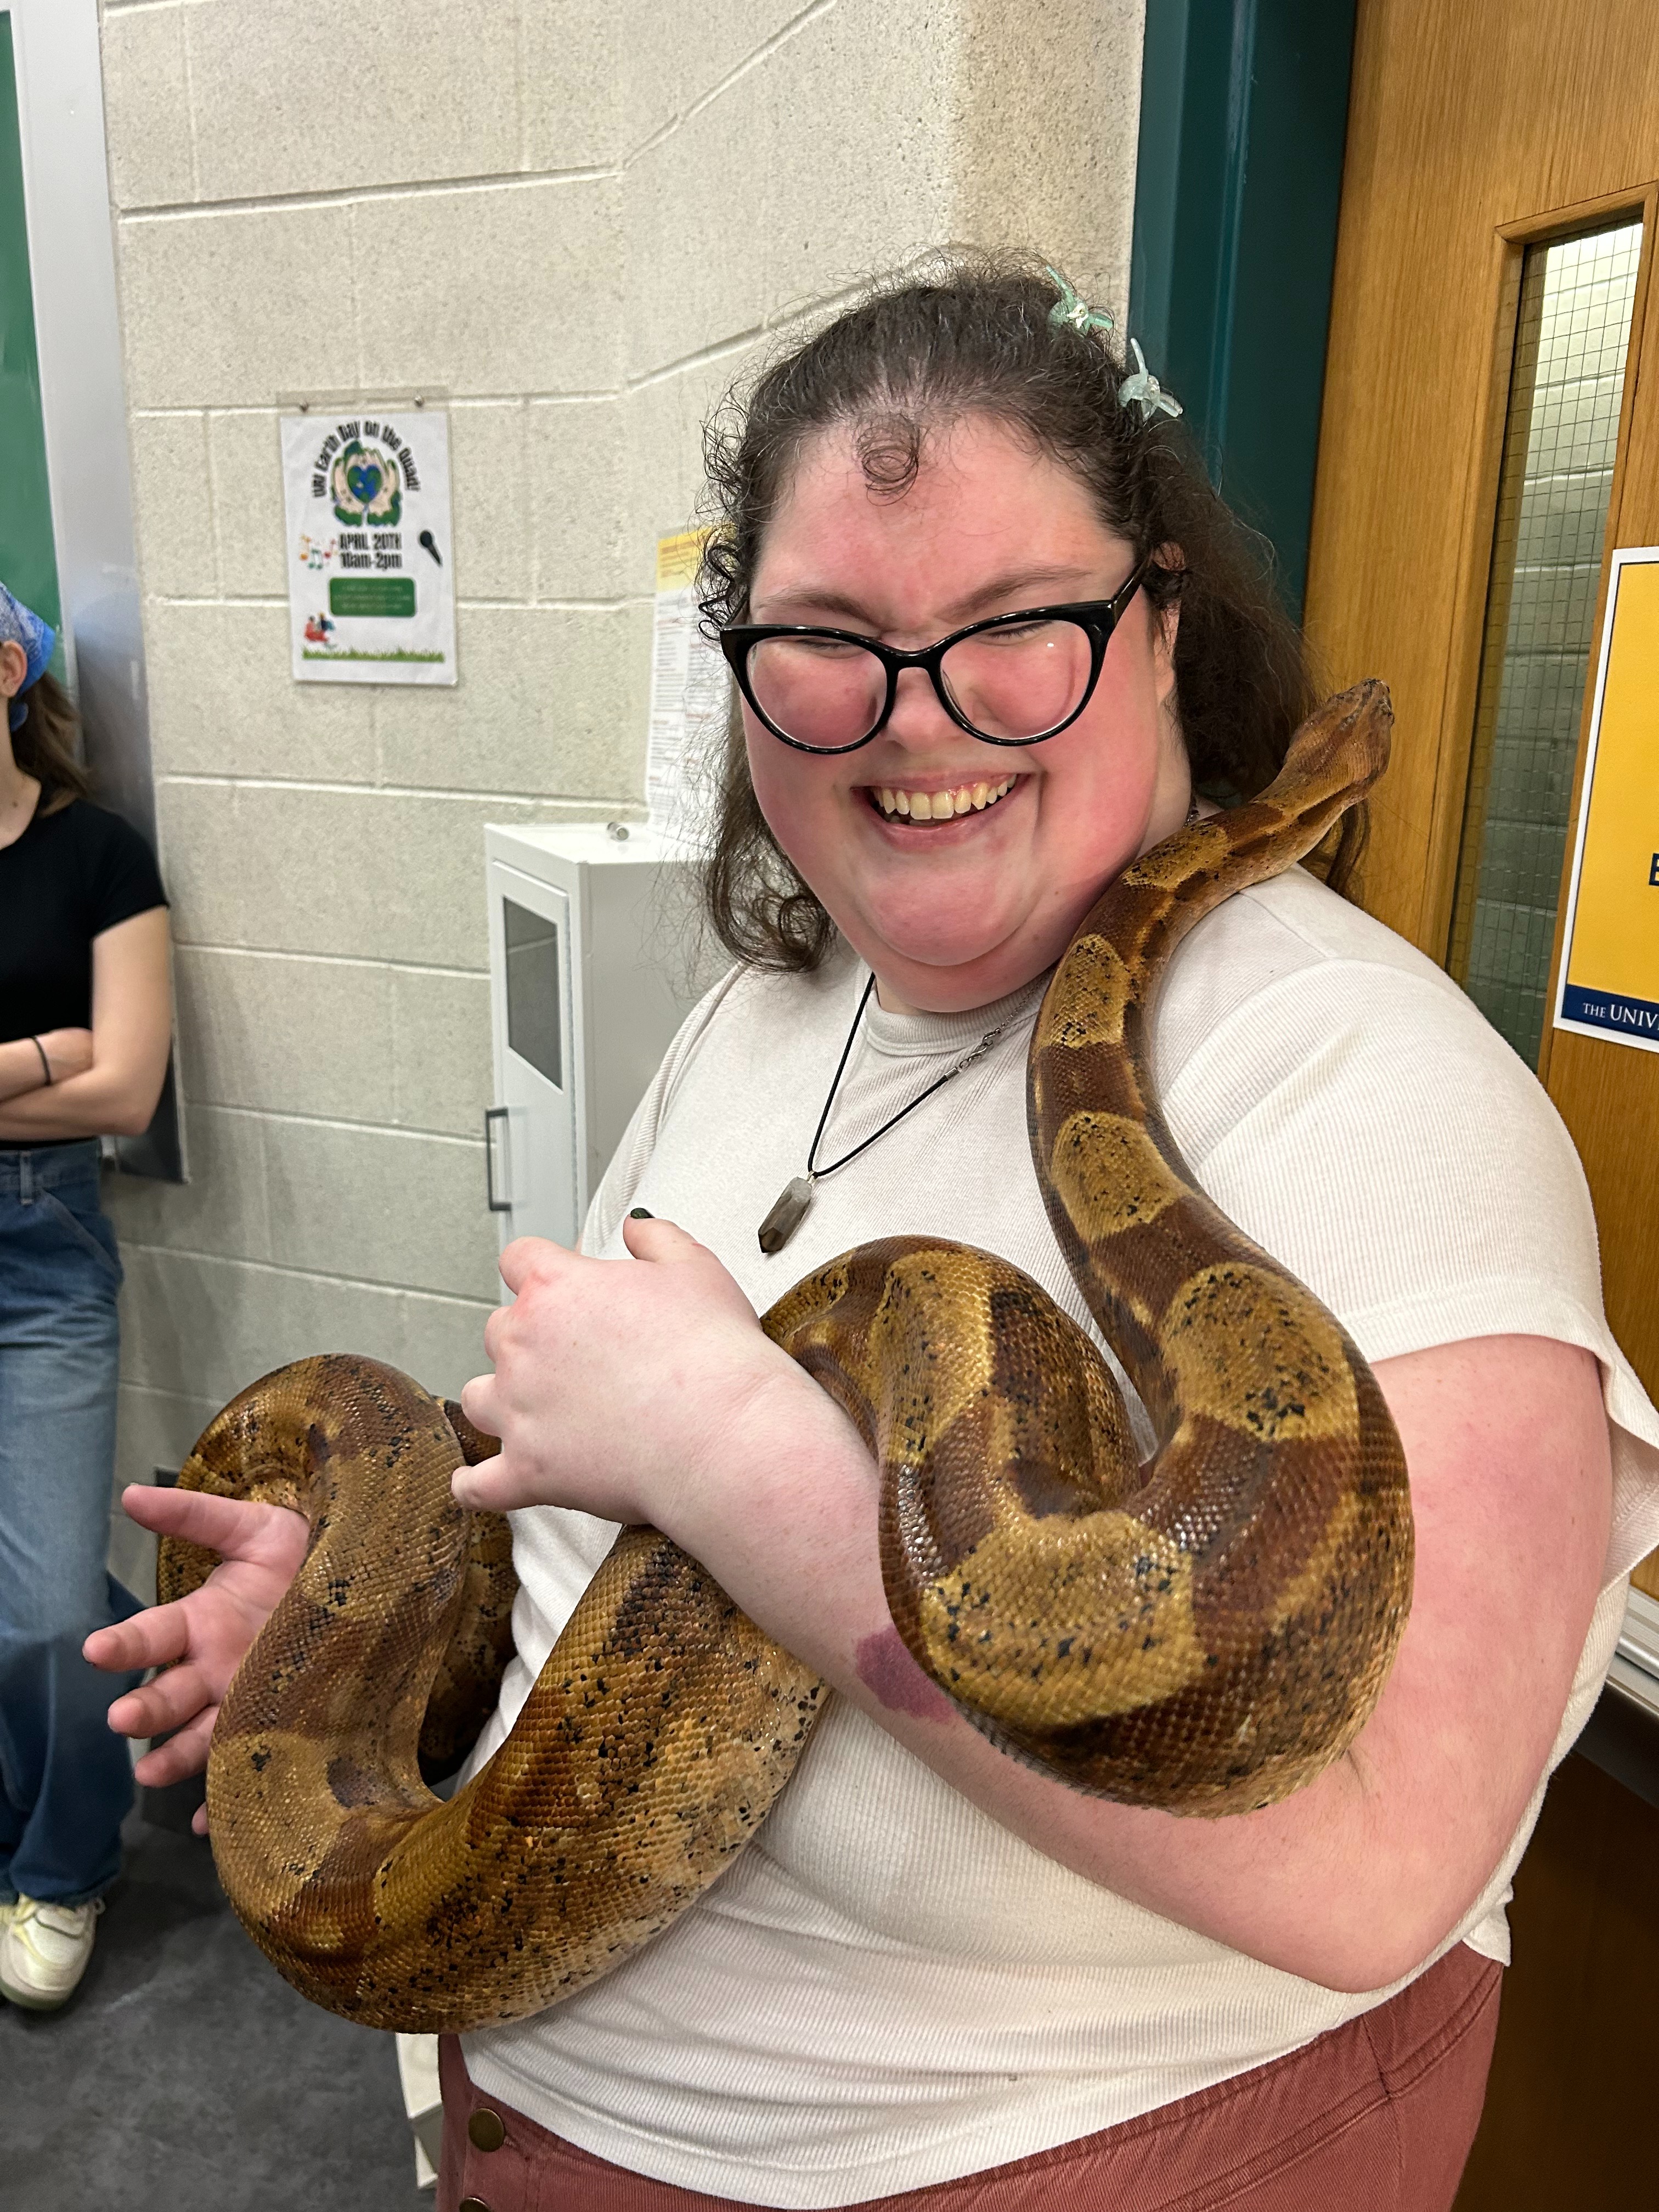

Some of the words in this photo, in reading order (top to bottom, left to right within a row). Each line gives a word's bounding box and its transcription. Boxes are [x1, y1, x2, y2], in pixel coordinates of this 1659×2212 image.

[315, 434, 341, 472] Earth
[337, 420, 361, 441] Day
[364, 420, 380, 438] on
[382, 425, 402, 451] the
[398, 447, 421, 491] Quad!
[339, 533, 369, 550] APRIL
[373, 533, 402, 550] 20TH
[341, 551, 403, 571] 10am-2pm
[1582, 1002, 1606, 1018] THE
[1610, 1004, 1659, 1031] UNIV
